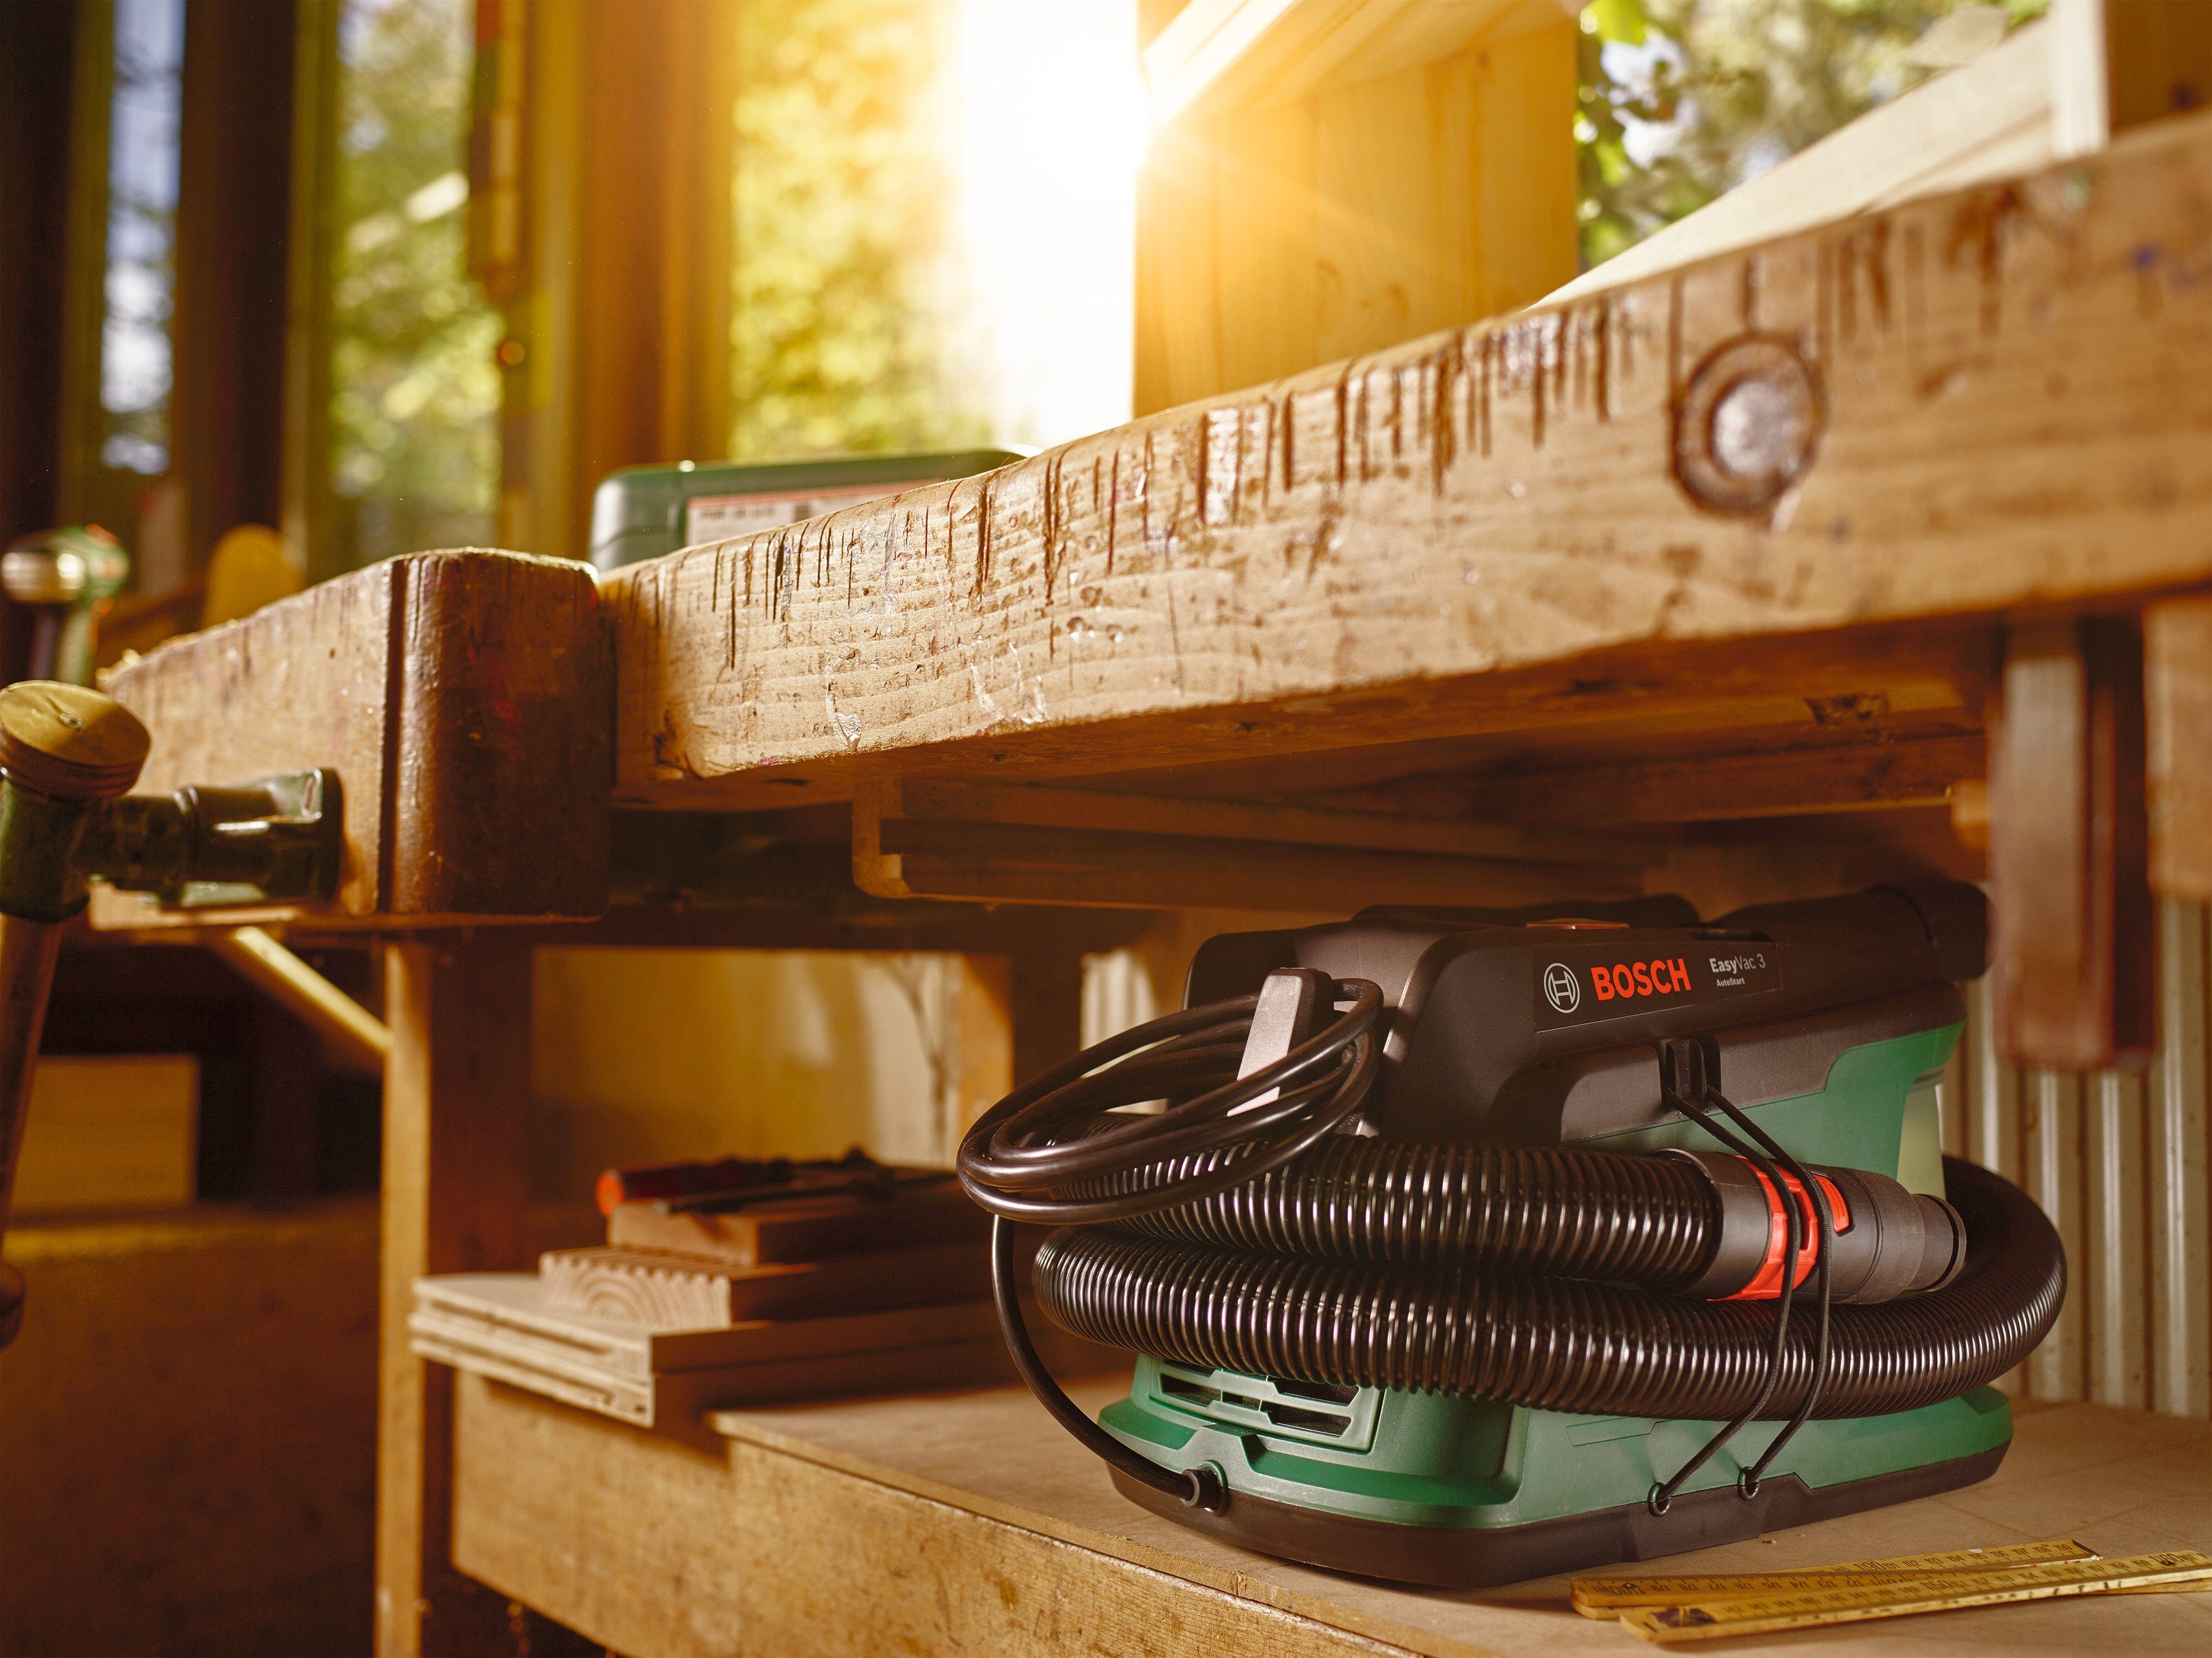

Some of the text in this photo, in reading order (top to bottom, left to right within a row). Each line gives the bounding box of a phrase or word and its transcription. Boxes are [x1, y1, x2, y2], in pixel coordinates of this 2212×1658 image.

[1709, 953, 1766, 974] EasyVac 3
[1590, 958, 1692, 1001] BOSCH
[1716, 977, 1745, 988] AutoStart
[1709, 1582, 1727, 1591] 177
